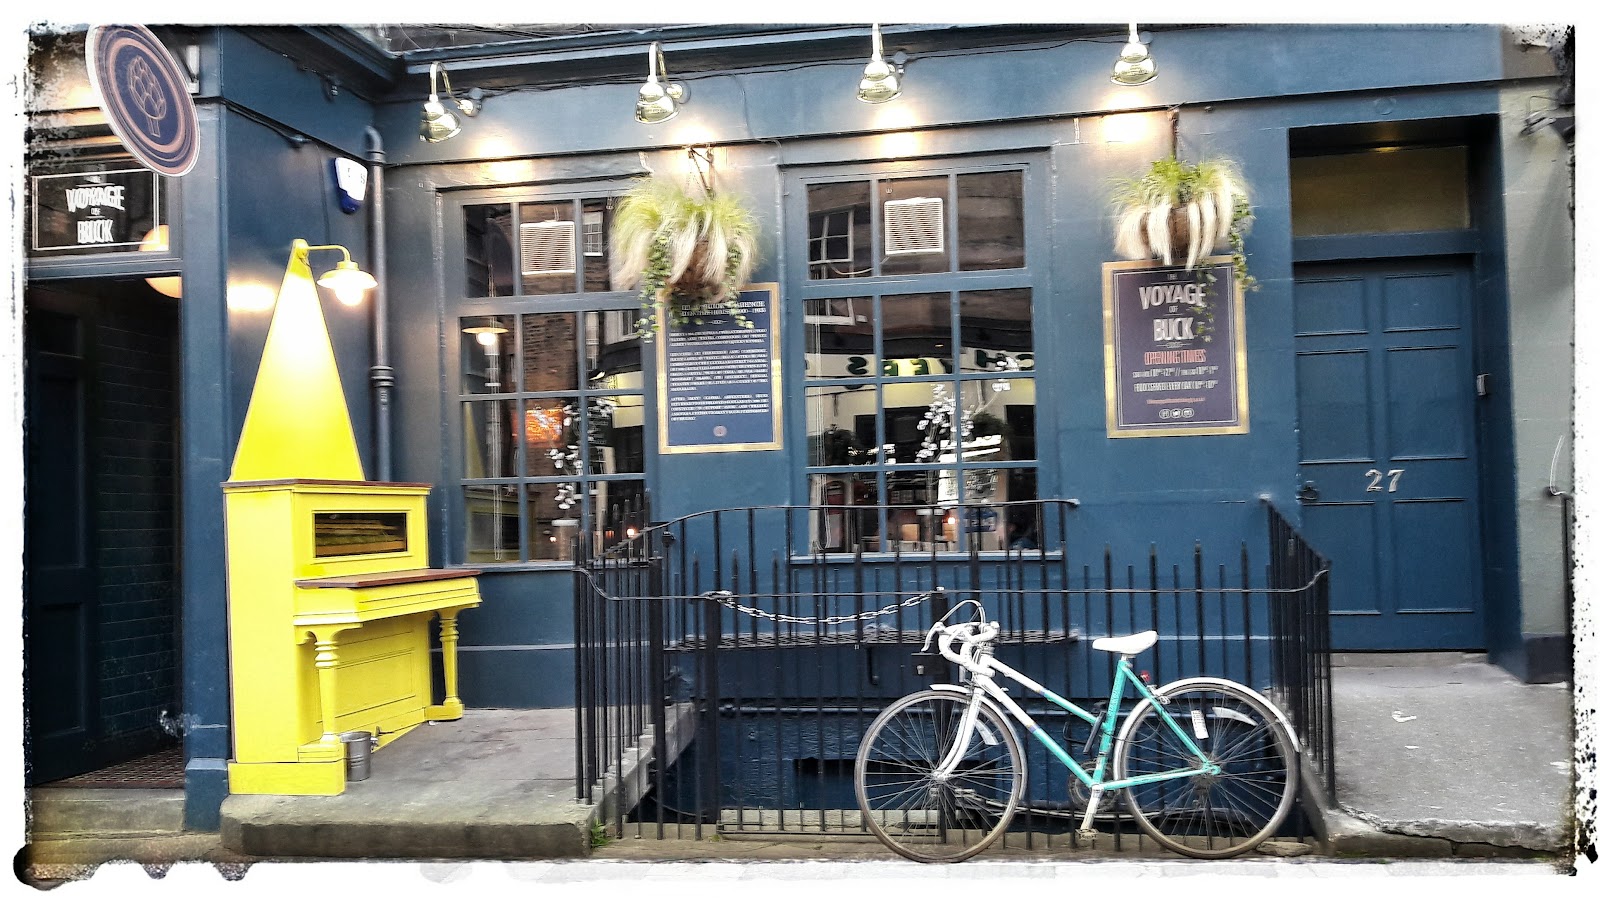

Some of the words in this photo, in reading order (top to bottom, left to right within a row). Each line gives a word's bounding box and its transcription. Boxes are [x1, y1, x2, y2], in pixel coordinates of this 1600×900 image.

[65, 186, 125, 213] VOYAGE
[77, 219, 114, 244] BUCK
[1139, 283, 1207, 310] VOYAGE
[1153, 317, 1195, 342] BUCK
[1365, 468, 1406, 493] 27
